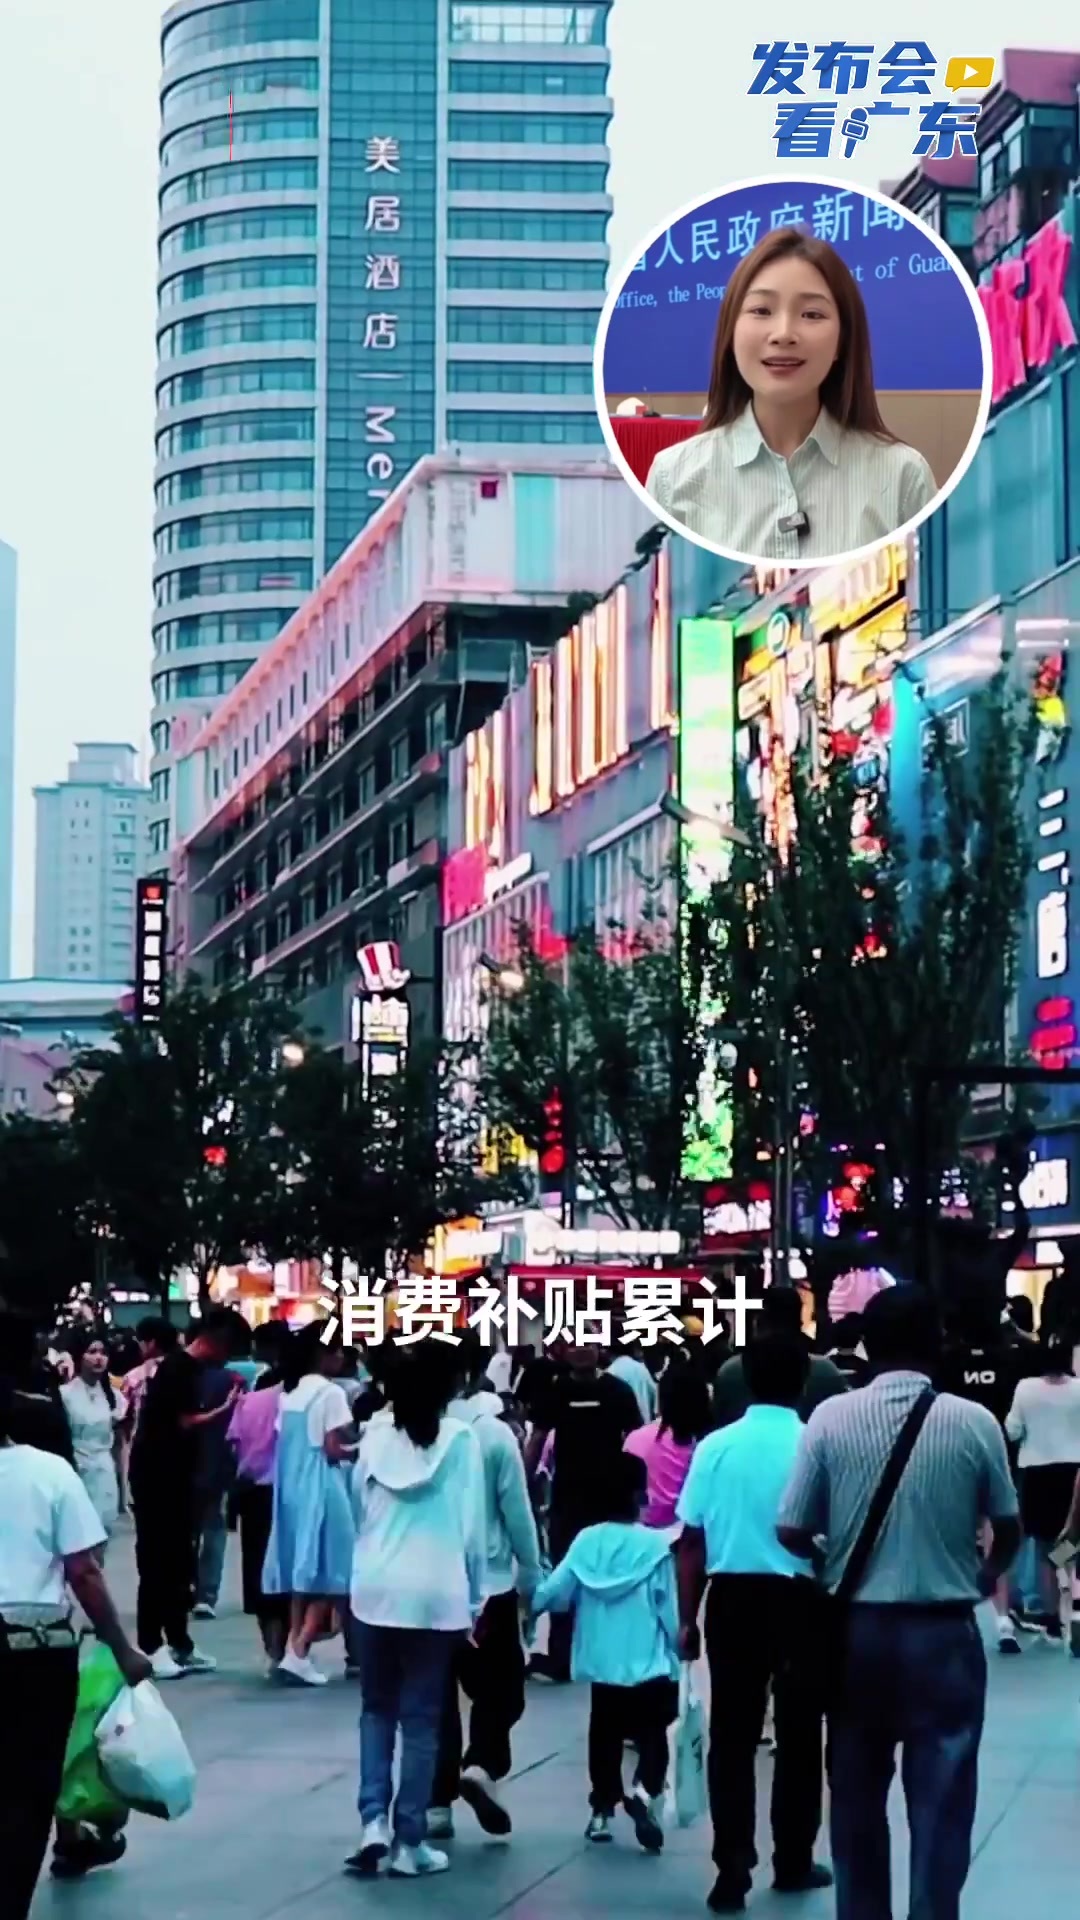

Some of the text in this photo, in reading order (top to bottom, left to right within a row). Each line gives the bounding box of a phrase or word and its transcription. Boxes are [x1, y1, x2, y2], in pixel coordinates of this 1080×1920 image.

[364, 136, 400, 350] 美居酒店
[875, 256, 899, 280] of
[668, 285, 690, 304] the
